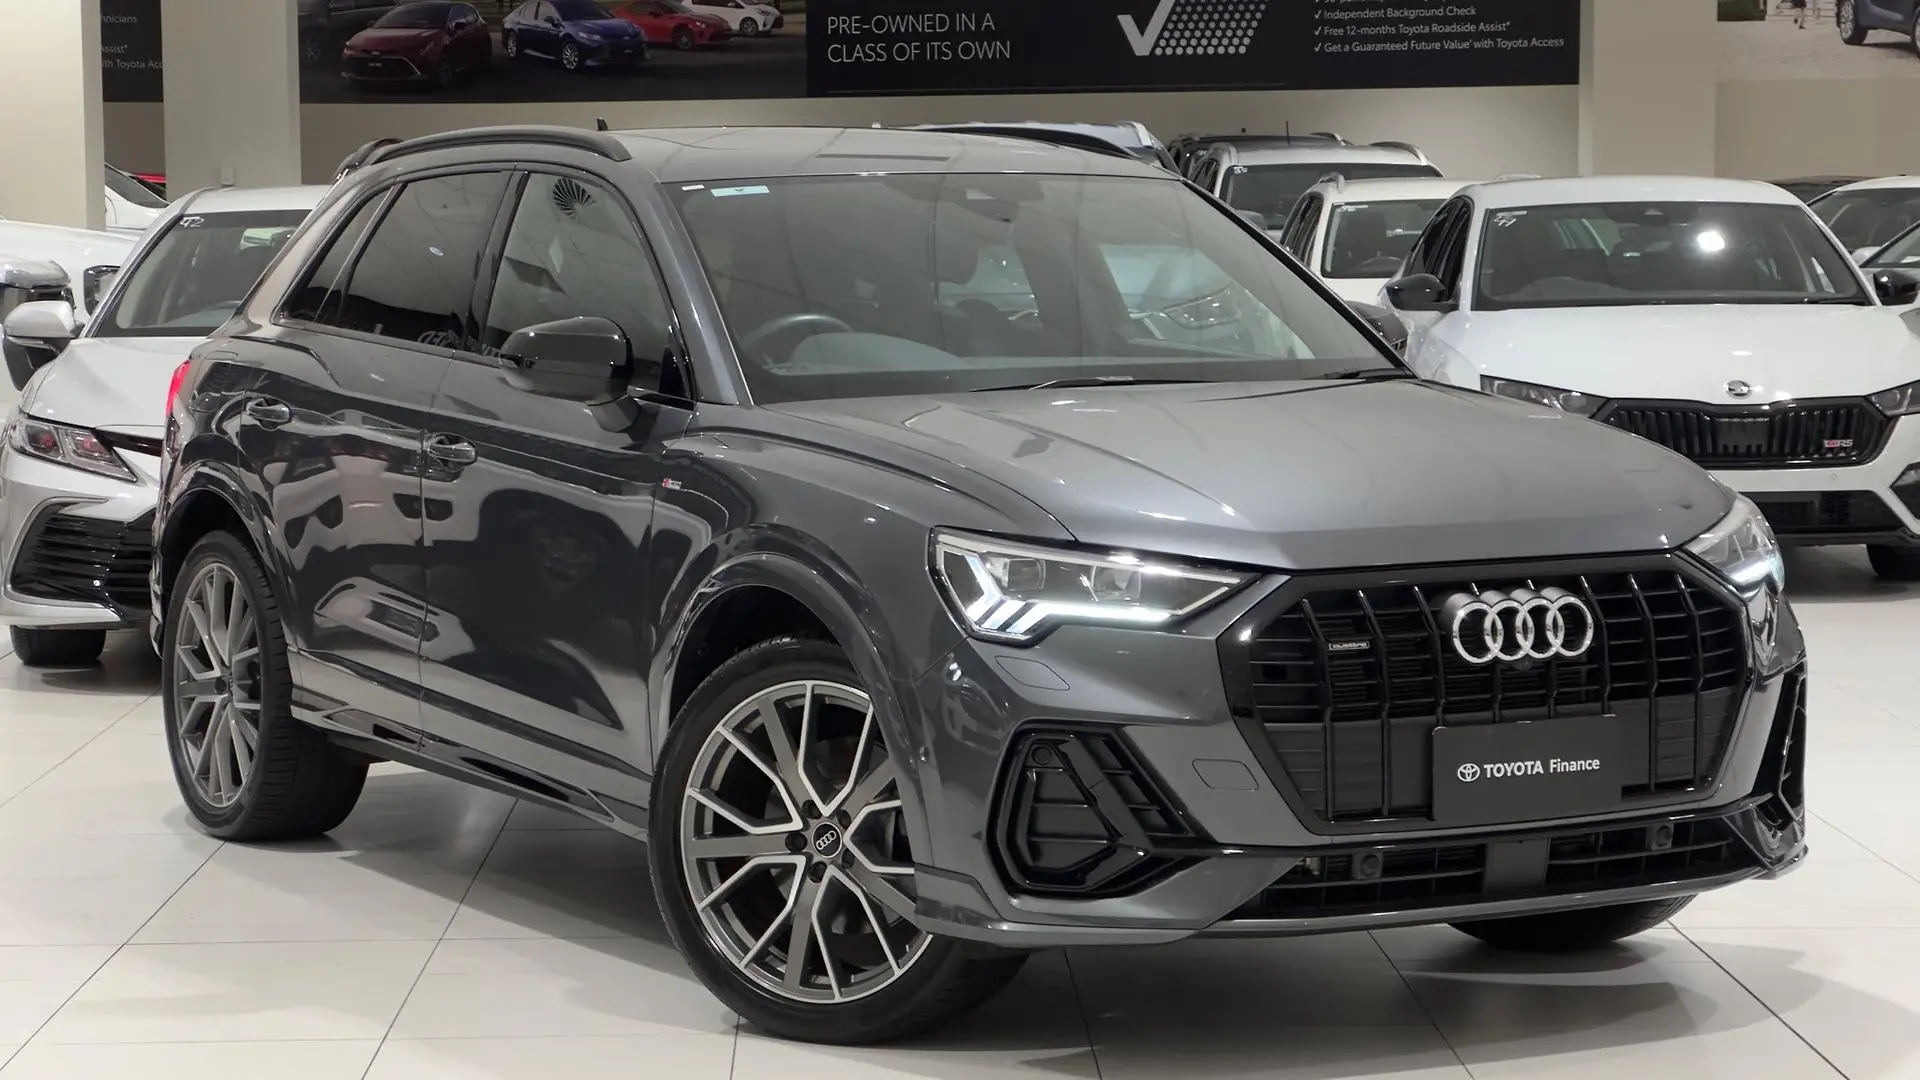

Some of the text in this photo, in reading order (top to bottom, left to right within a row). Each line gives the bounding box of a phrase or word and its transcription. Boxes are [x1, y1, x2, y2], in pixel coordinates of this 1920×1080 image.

[1324, 6, 1476, 20] Independent Background Check
[828, 13, 995, 34] PRE-OWNED IN A
[1324, 26, 1344, 36] Free
[1346, 24, 1396, 35] 12-months
[1399, 24, 1430, 36] Toyota
[1431, 22, 1476, 32] Roadside
[827, 40, 1010, 63] CLASS OF ITS OWN
[1324, 43, 1342, 52] Get
[1343, 44, 1349, 52] a
[1352, 41, 1408, 51] Guaranteed
[1410, 40, 1440, 50] Future
[1473, 38, 1494, 48] with
[1496, 38, 1528, 49] Toyota
[1530, 37, 1564, 47] Access
[115, 59, 146, 70] Toyota
[1483, 758, 1600, 778] TOYOTA Finance
